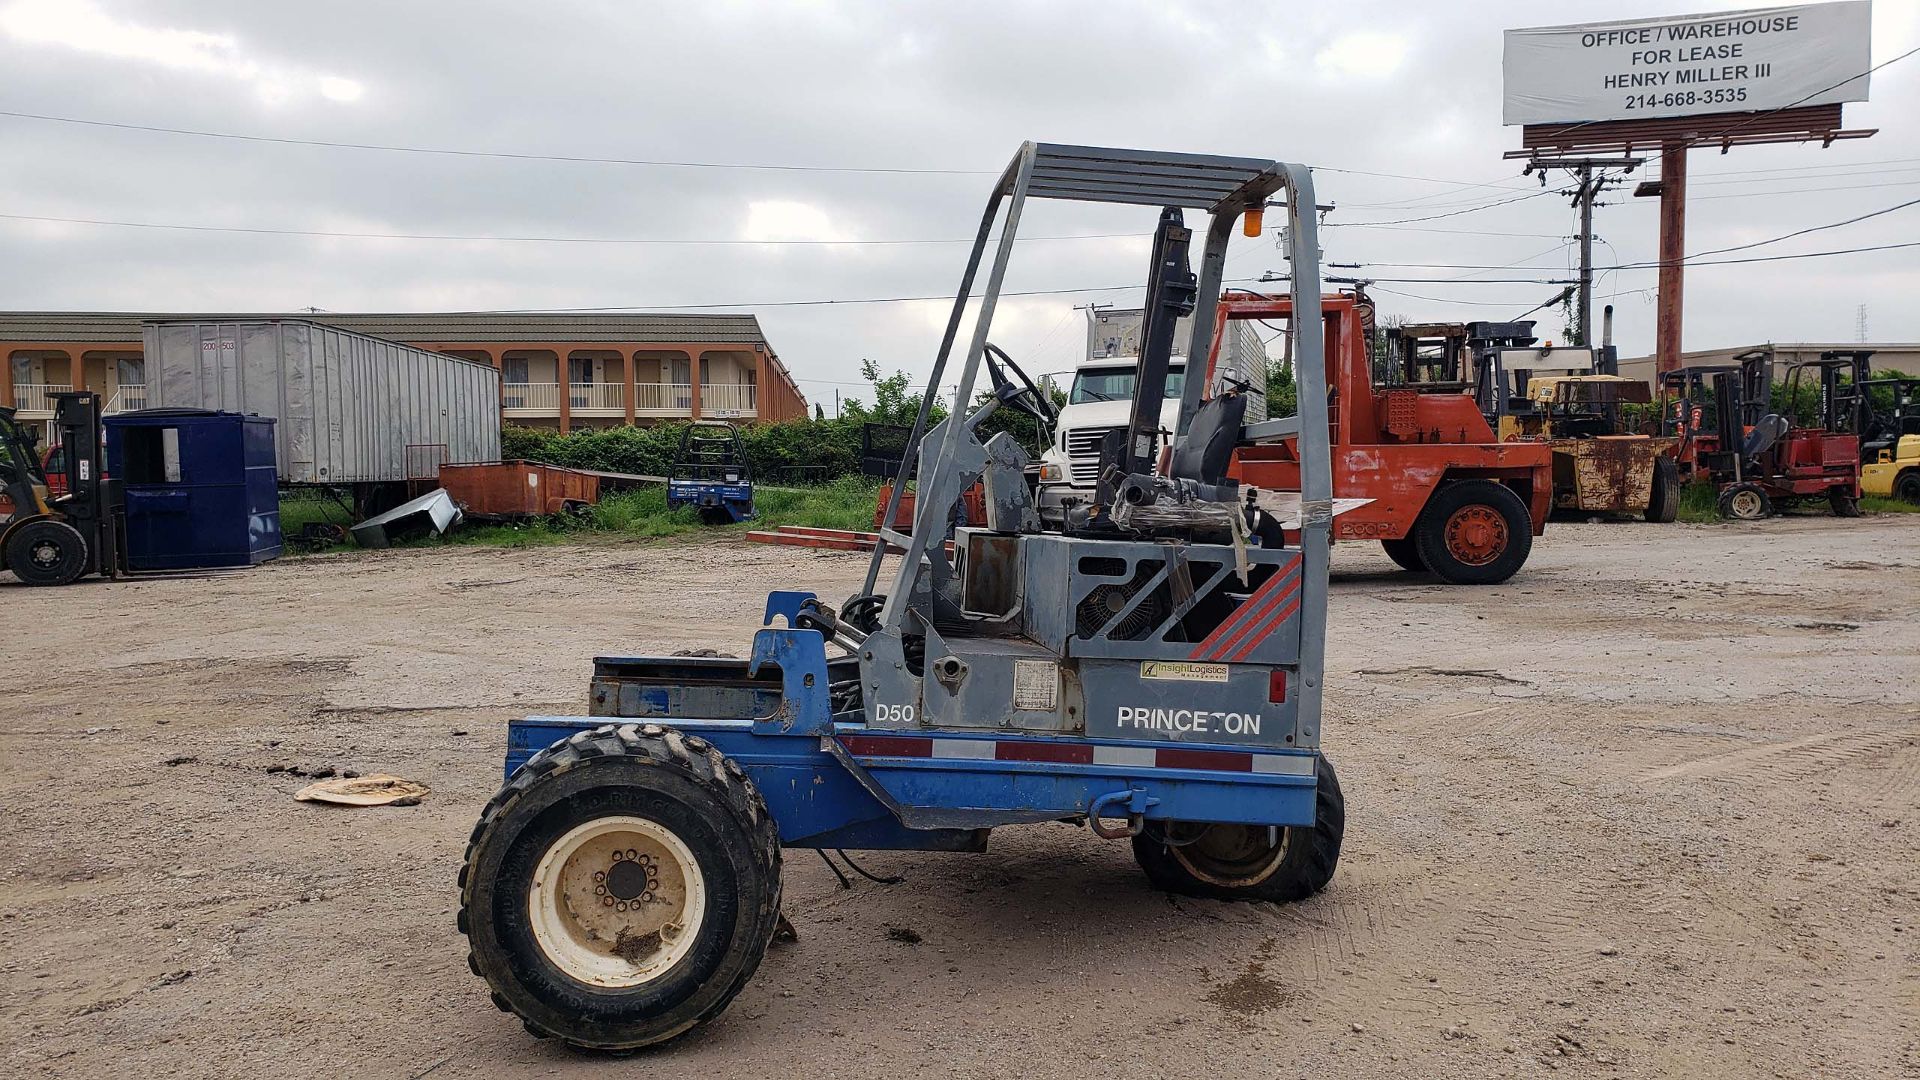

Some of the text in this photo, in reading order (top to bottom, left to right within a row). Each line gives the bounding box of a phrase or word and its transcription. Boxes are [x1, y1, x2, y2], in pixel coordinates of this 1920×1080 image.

[1581, 16, 1799, 48] OFFICE / WAREHOUSE
[1632, 43, 1743, 65] FOR LEASE
[1604, 63, 1771, 89] HENRY MILLER III
[1625, 87, 1748, 109] 214-668-3535
[875, 703, 915, 722] D50
